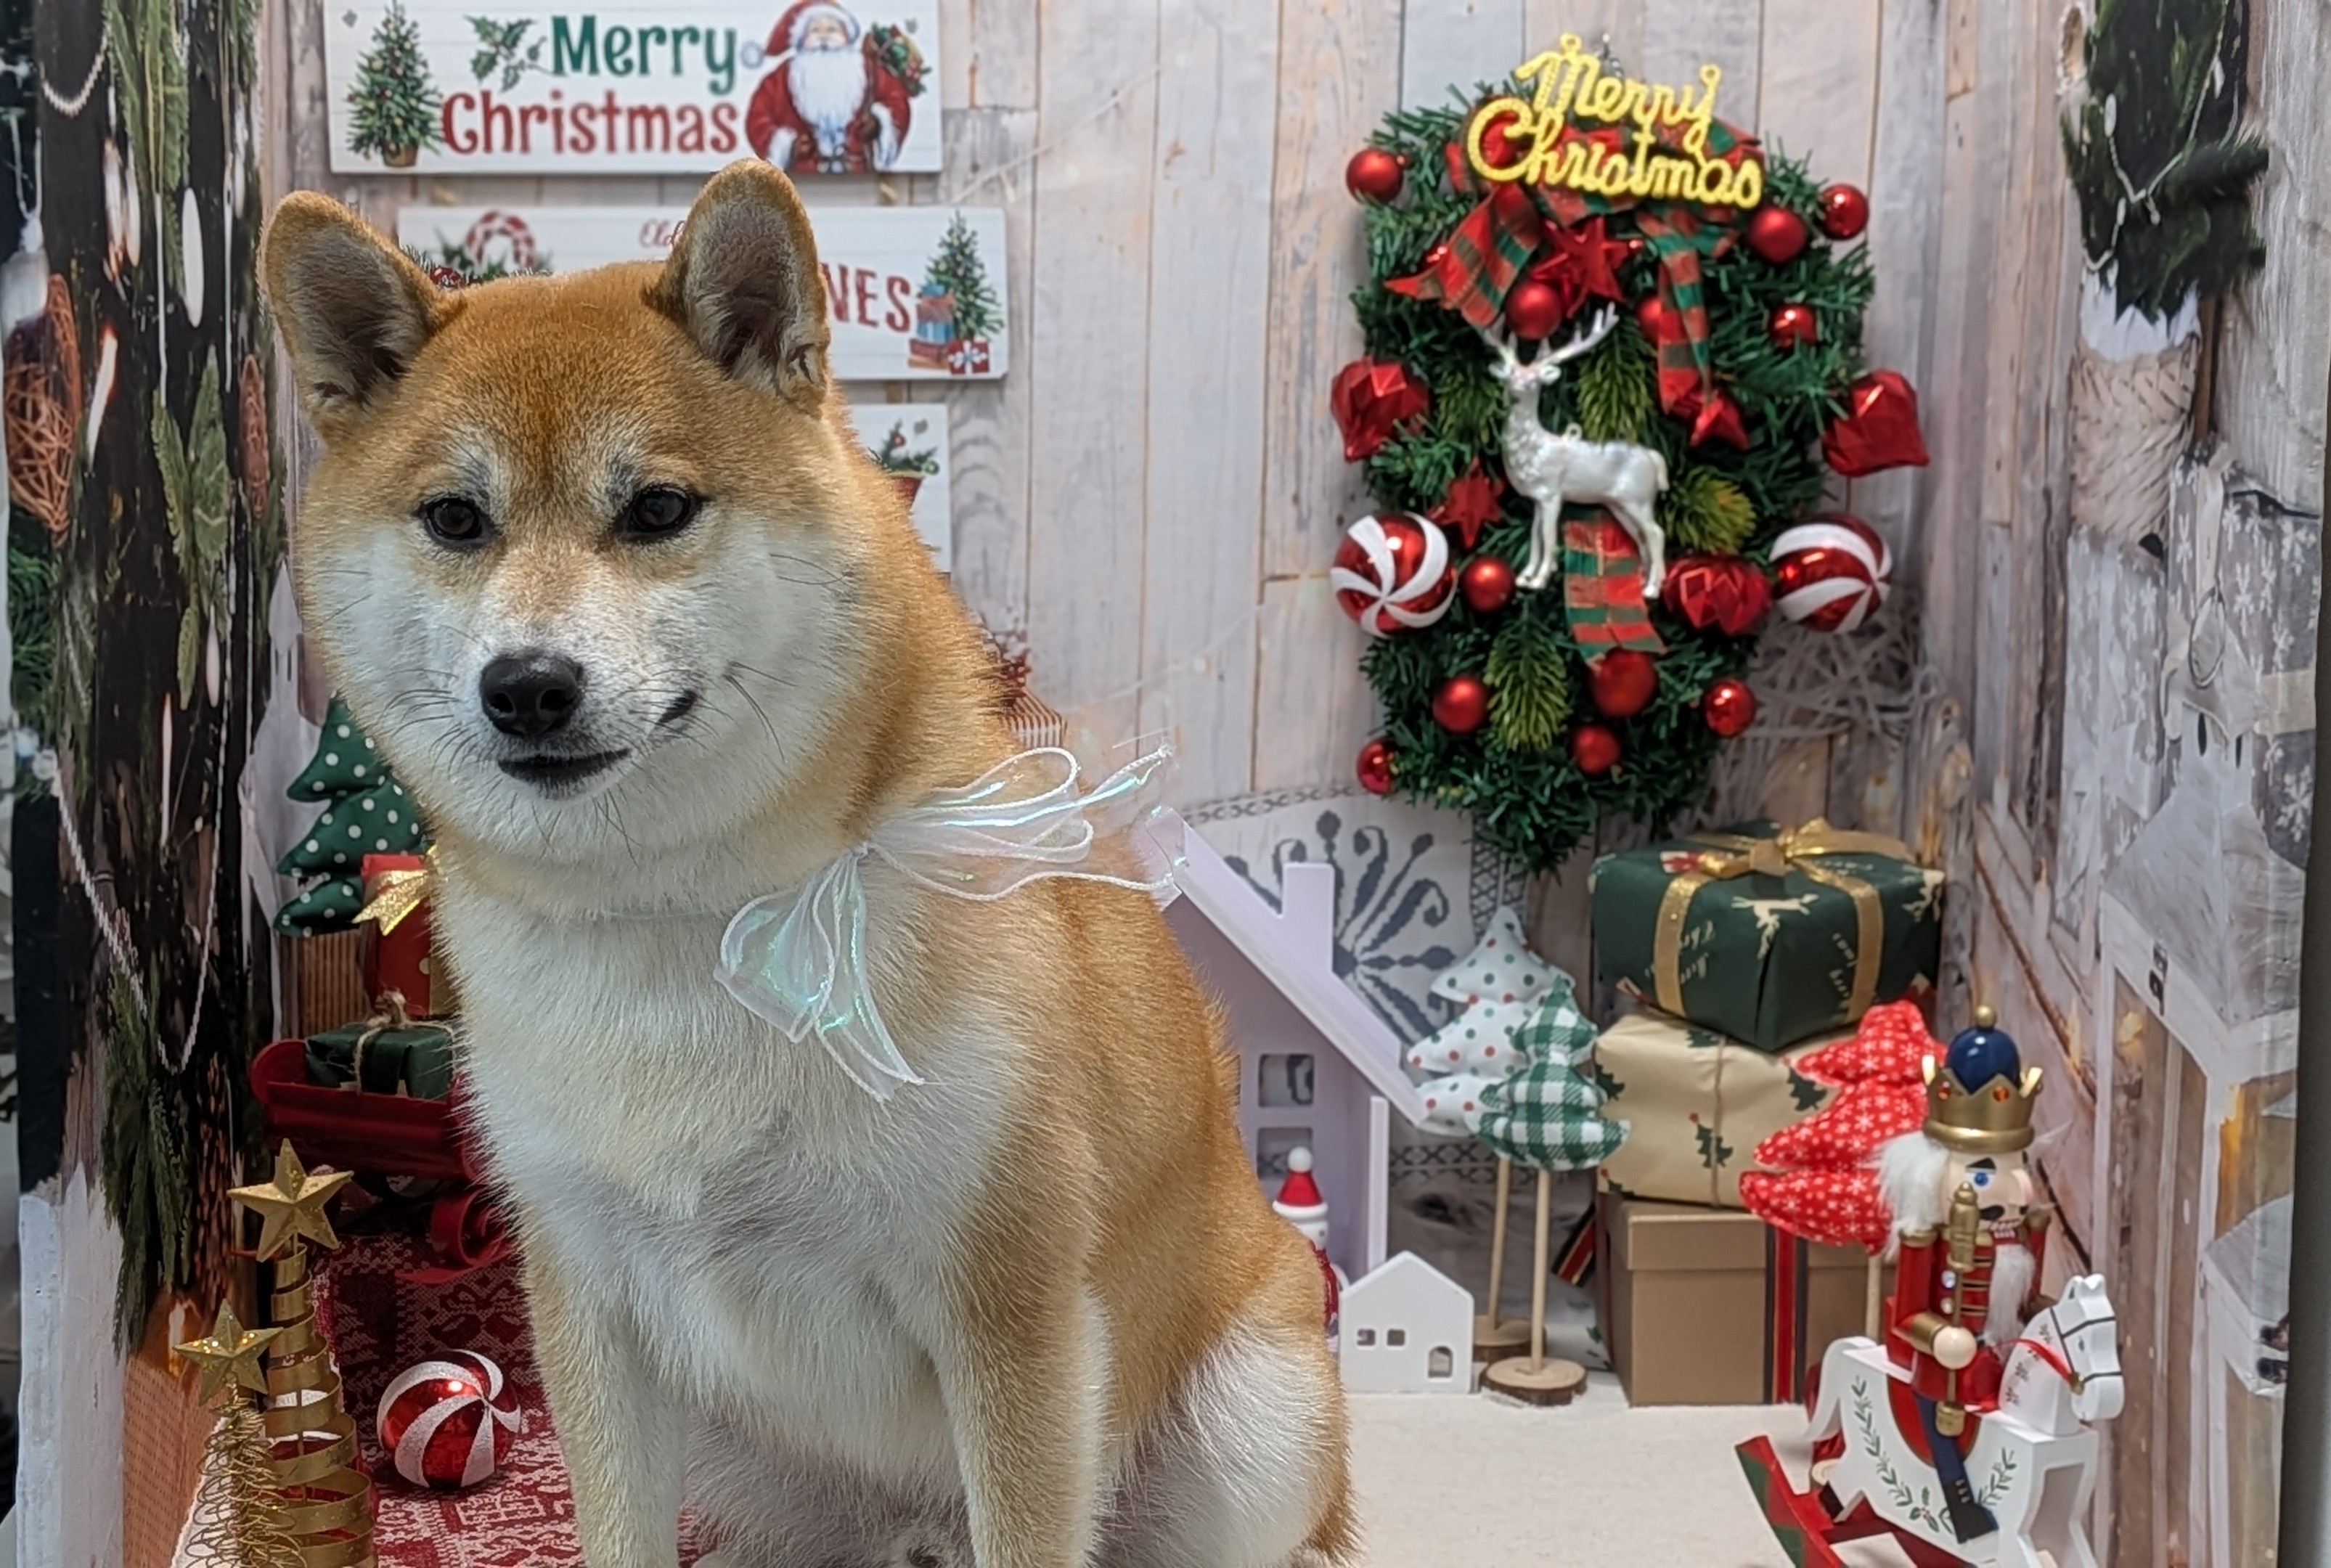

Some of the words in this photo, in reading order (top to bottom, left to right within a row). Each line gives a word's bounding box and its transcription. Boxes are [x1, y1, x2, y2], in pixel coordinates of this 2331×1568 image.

[552, 15, 737, 96] Merry
[442, 89, 738, 155] Christmas
[1516, 44, 1721, 155] Merry
[1467, 98, 1763, 209] Christmas
[820, 261, 912, 333] NES
